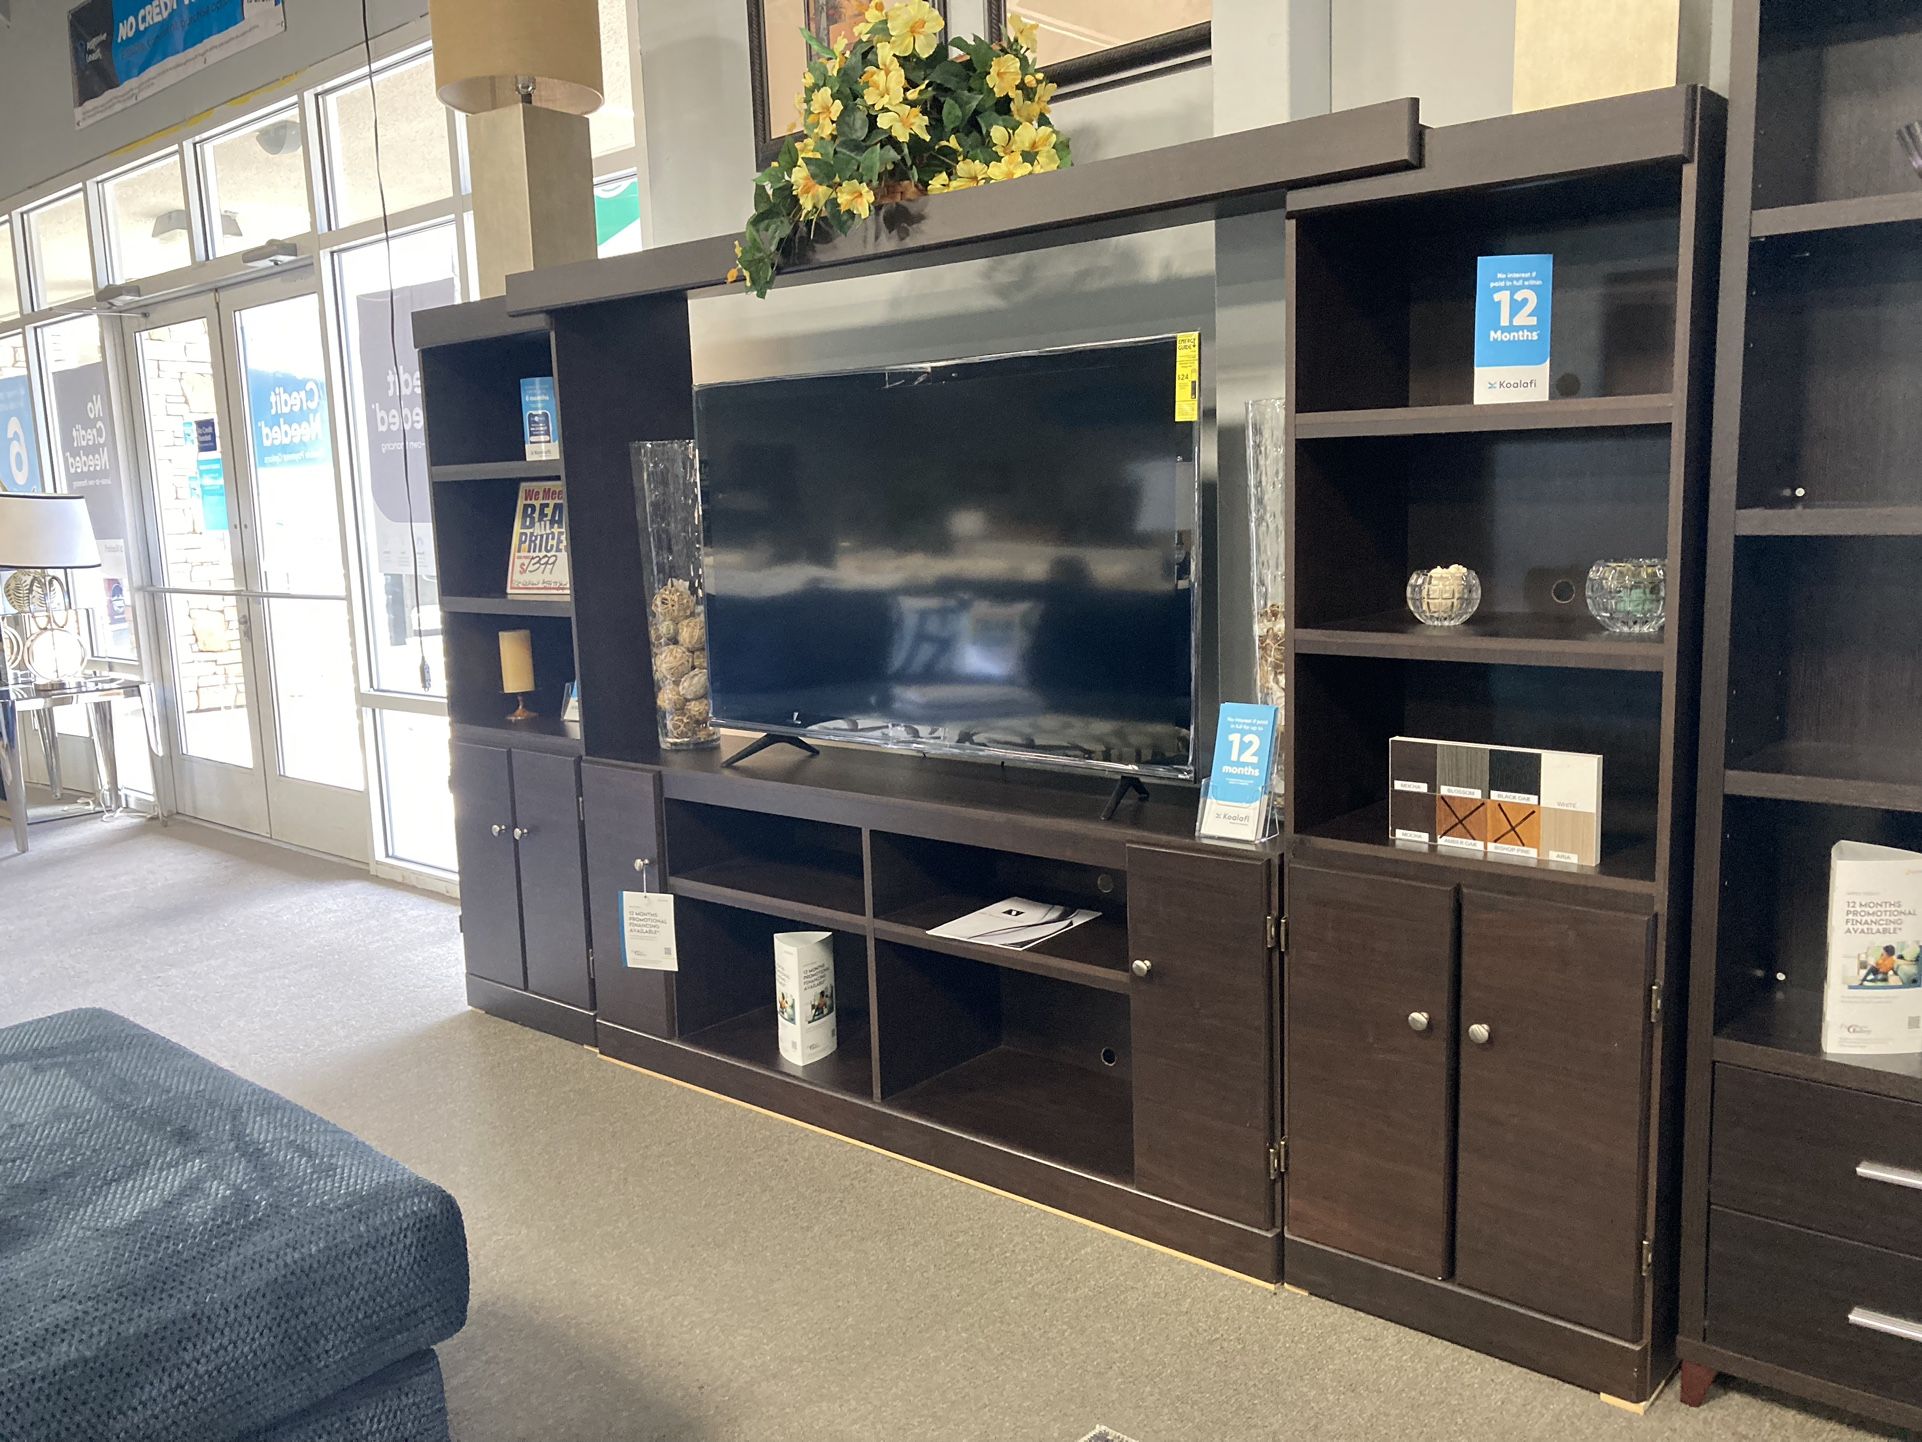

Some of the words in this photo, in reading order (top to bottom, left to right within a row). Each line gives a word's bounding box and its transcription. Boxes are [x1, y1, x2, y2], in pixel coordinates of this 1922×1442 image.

[117, 15, 136, 43] NO
[1493, 288, 1538, 327] 12
[1499, 379, 1537, 389] Koalafi
[524, 488, 540, 502] We
[517, 530, 568, 554] PRICE
[1228, 732, 1261, 764] 12
[1222, 765, 1260, 777] months
[1497, 792, 1517, 800] BLACK
[1556, 801, 1578, 809] WHITE
[1223, 813, 1250, 823] Koalafi
[1401, 831, 1423, 839] MOCHA
[1846, 900, 1857, 909] 12
[1858, 900, 1903, 909] MONTHS
[1845, 909, 1918, 918] PROMOTIONAL
[1845, 918, 1904, 927] FINANCING
